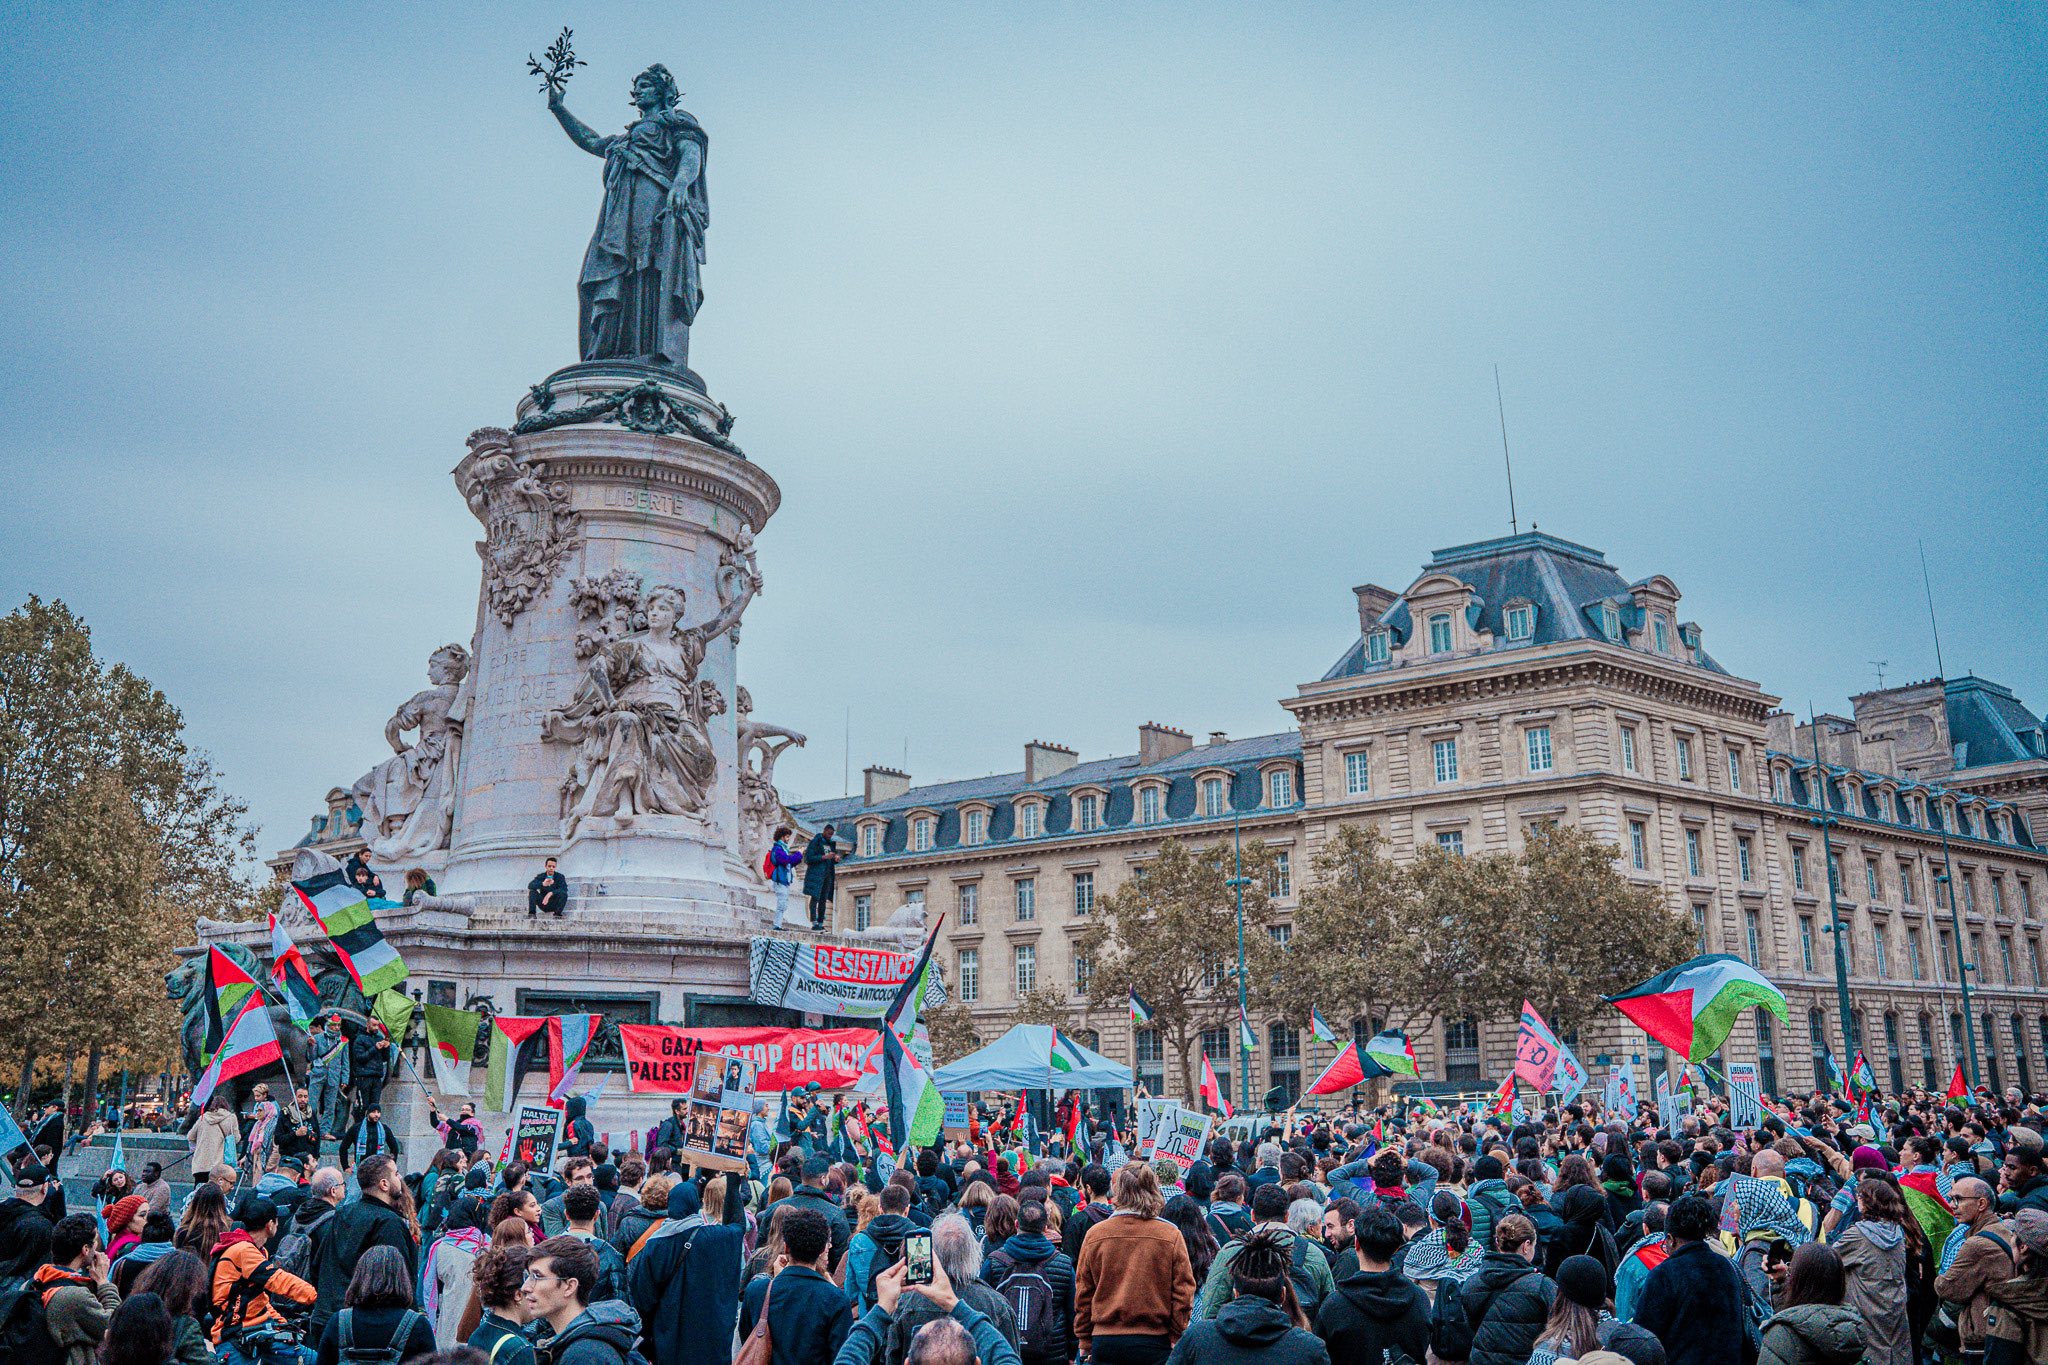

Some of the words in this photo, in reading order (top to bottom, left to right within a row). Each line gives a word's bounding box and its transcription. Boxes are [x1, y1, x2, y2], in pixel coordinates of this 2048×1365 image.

[816, 946, 915, 982] RÉSISTANCE
[796, 978, 858, 1000] ANTISIONISTE
[661, 1036, 703, 1056] GAZA
[724, 1043, 783, 1073] STOP
[1730, 1065, 1754, 1074] LIBÉRATION
[523, 1110, 549, 1119] HALTE
[1182, 1116, 1205, 1131] GAZA
[519, 1125, 554, 1137] GAZA
[1187, 1137, 1200, 1148] ON
[1183, 1144, 1197, 1157] TUE
